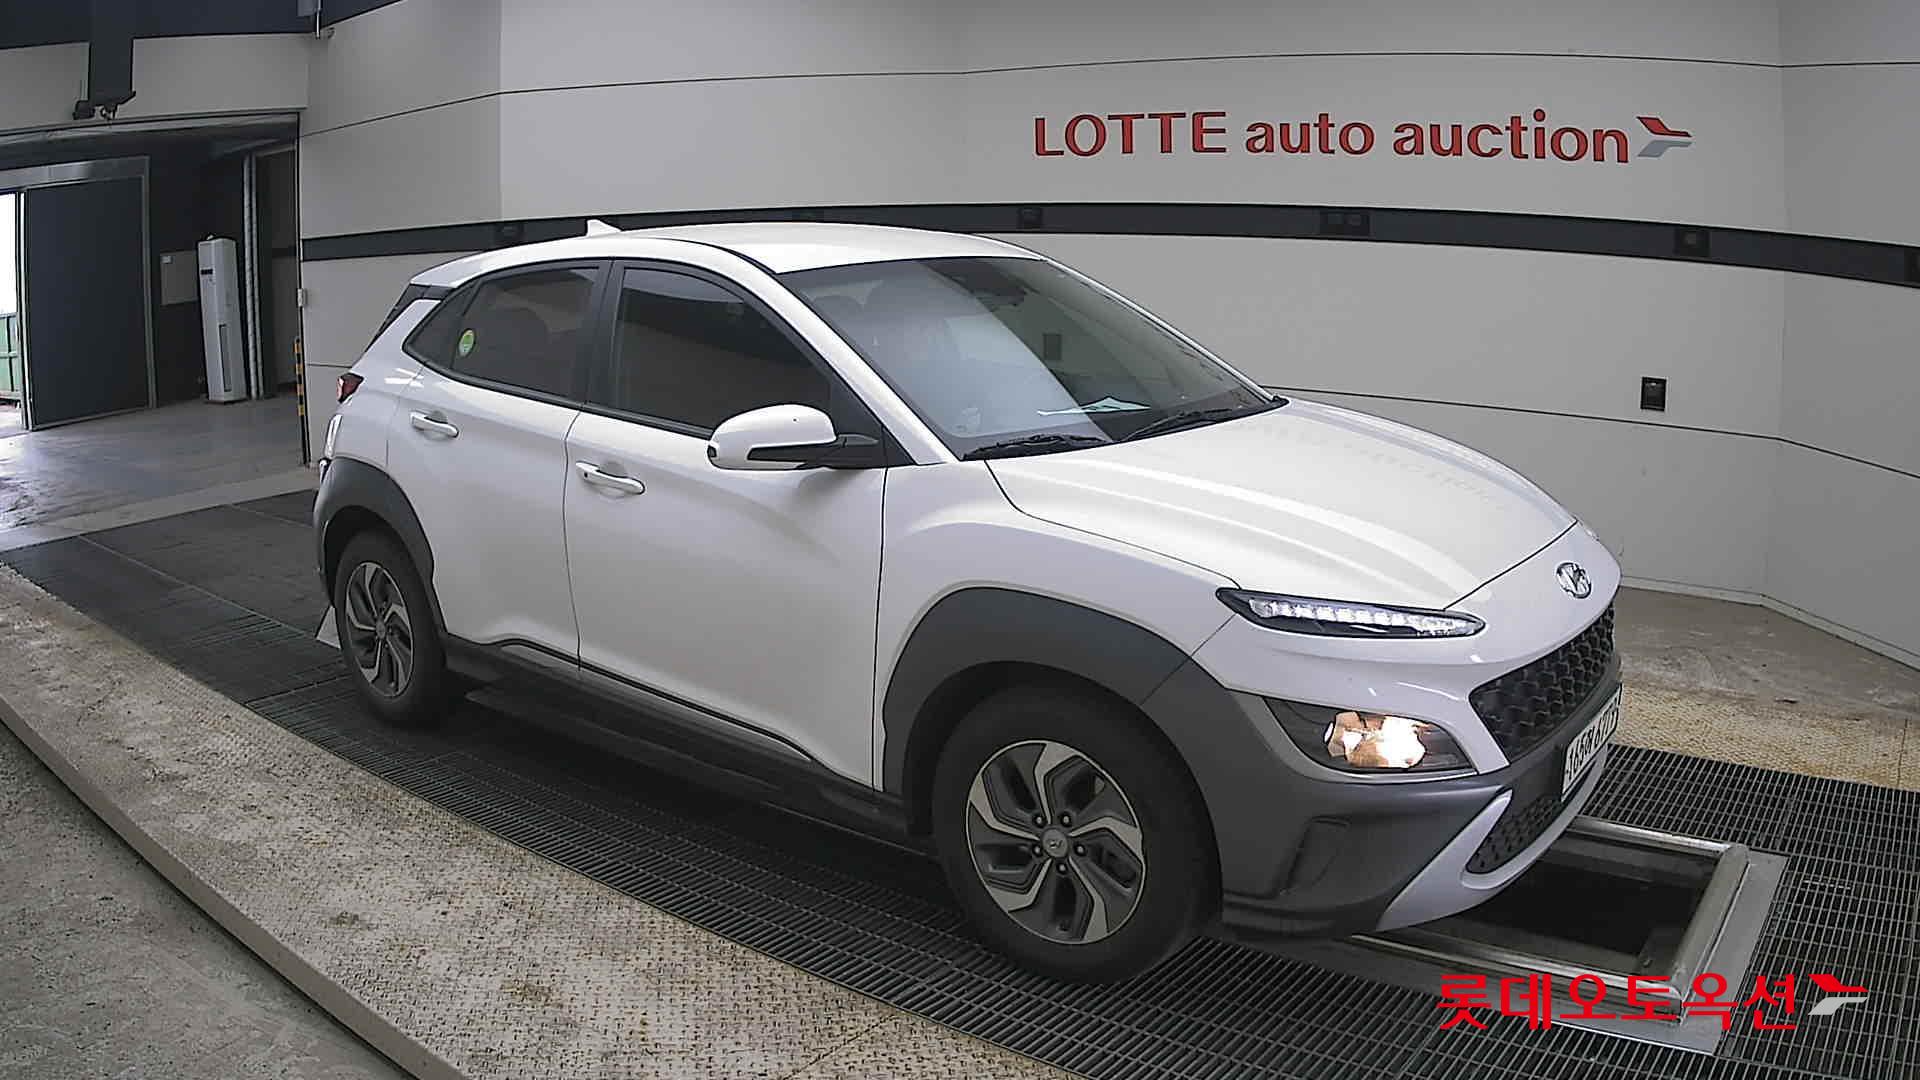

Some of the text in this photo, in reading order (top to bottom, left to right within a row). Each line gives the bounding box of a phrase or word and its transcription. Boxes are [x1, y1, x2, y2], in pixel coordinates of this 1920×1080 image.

[1035, 108, 1630, 164] LOTTE auto auction
